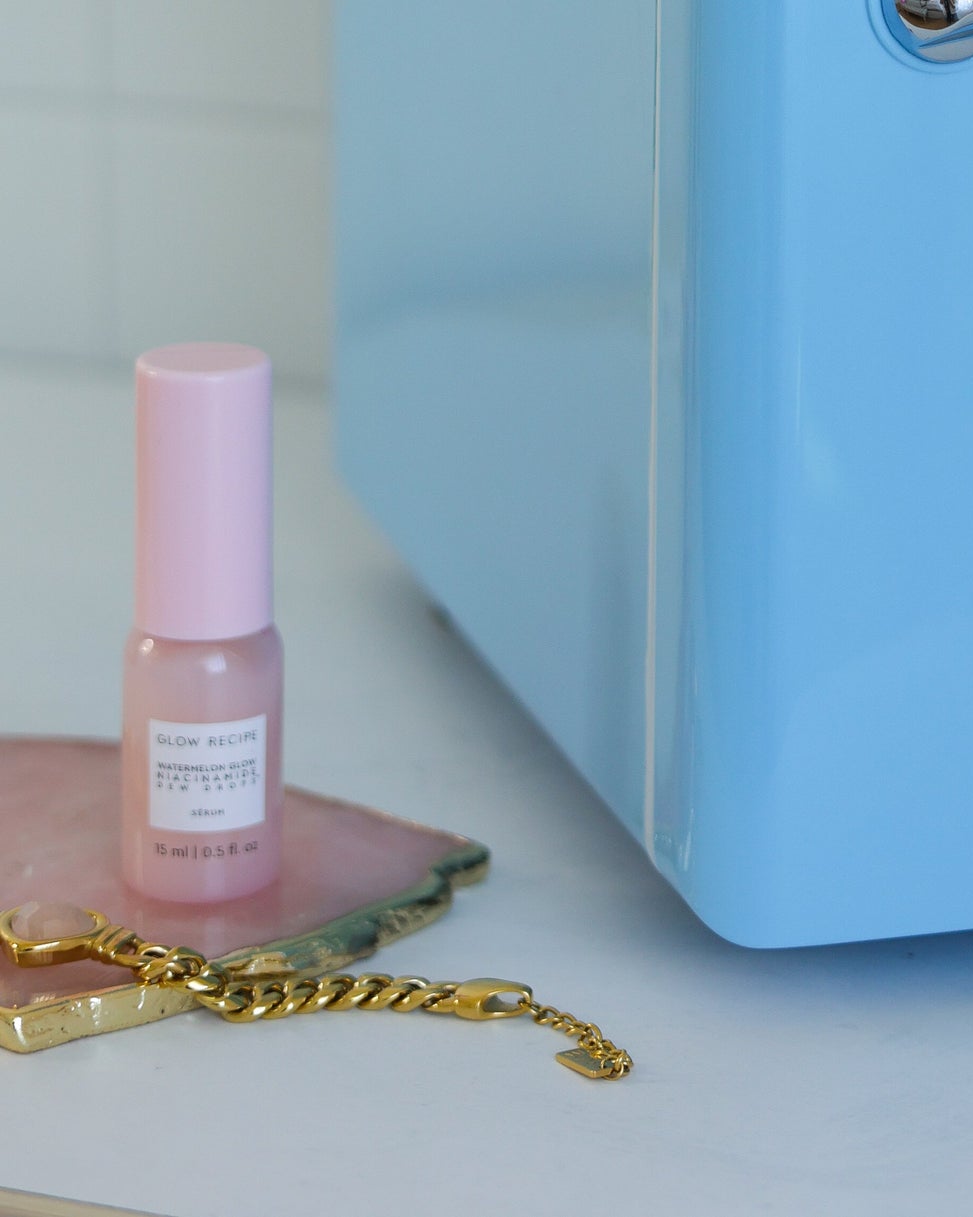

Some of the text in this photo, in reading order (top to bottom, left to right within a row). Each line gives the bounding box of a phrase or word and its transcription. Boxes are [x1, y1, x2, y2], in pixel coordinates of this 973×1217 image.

[157, 730, 258, 747] GLOW RECIPE
[157, 759, 256, 773] WATERMELON GLOW
[156, 842, 168, 855] 15
[172, 845, 189, 858] ml
[203, 844, 225, 858] 0.5
